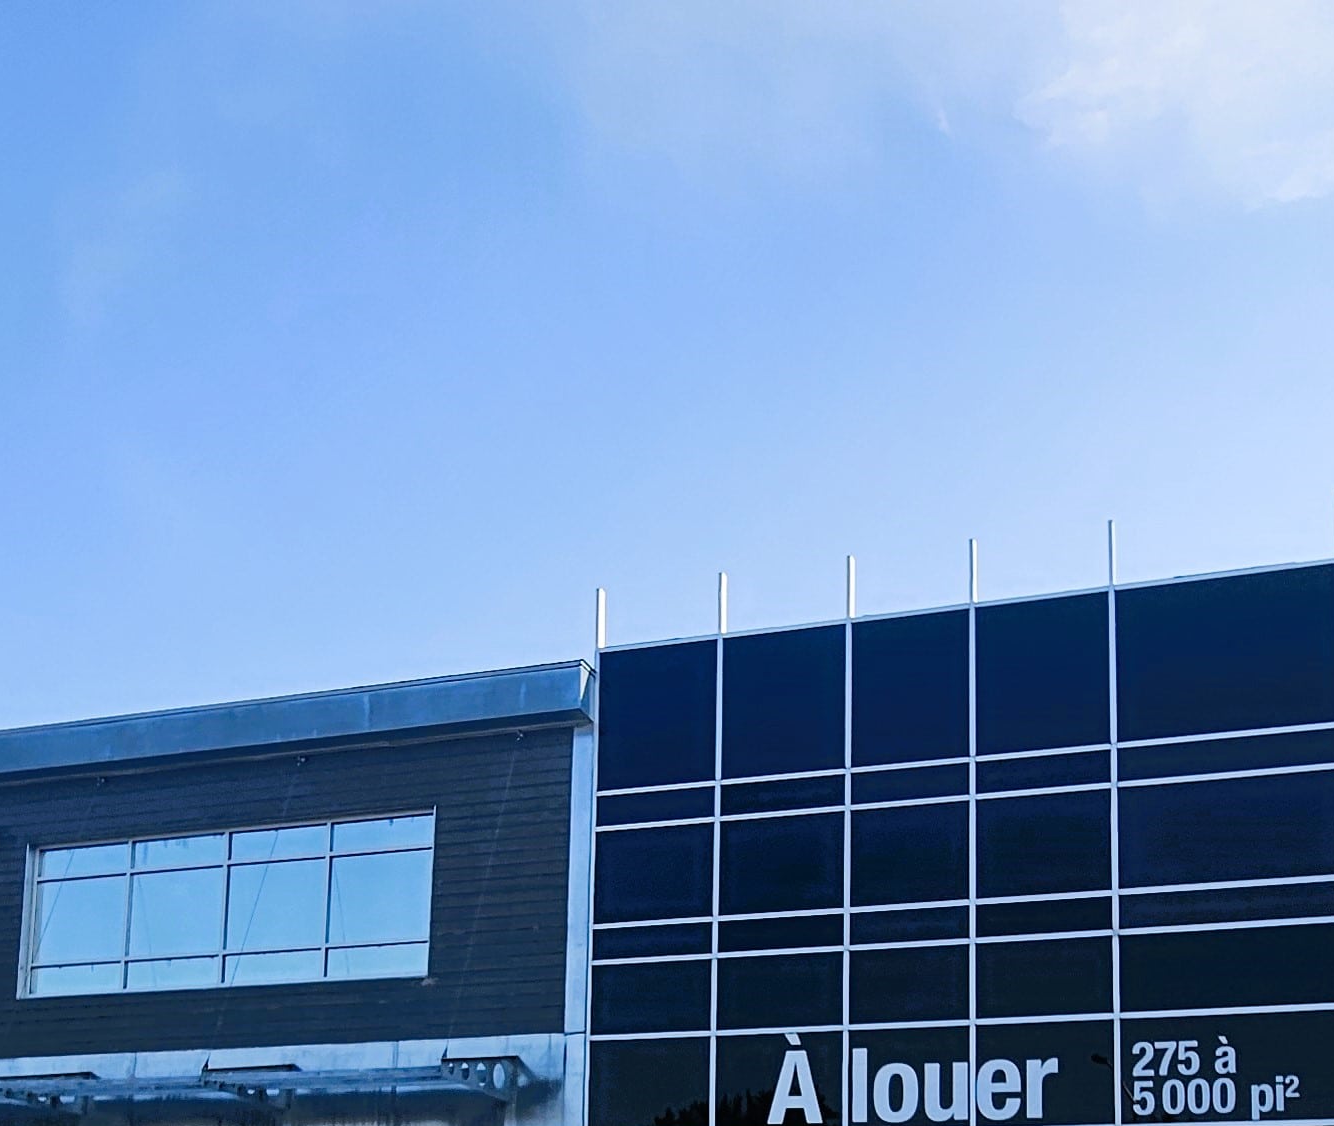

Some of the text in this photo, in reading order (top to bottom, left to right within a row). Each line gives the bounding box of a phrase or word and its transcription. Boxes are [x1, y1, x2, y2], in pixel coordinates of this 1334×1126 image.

[767, 1033, 1059, 1125] À louer
[1132, 1035, 1237, 1077] 275 à
